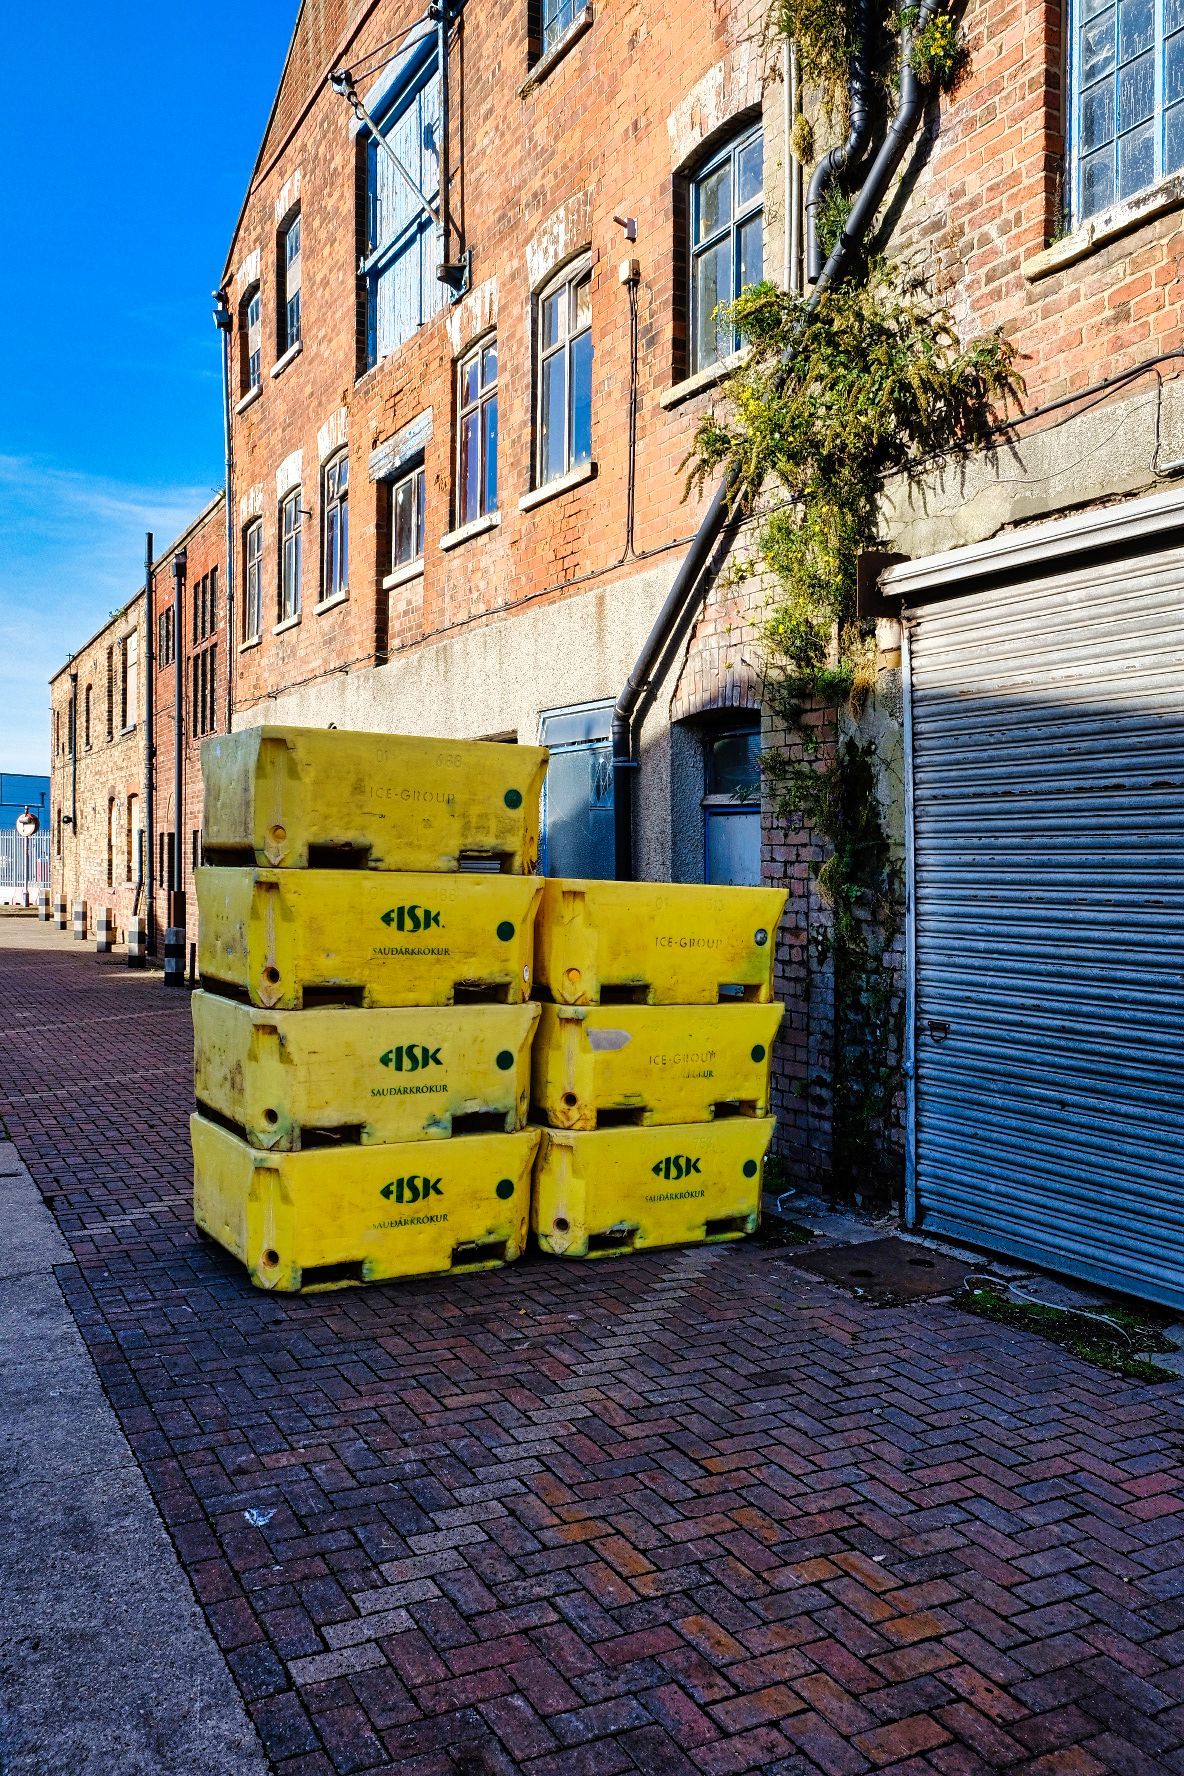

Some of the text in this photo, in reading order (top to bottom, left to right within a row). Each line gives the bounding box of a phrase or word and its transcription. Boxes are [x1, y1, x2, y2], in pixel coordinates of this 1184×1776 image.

[370, 786, 456, 804] ICE-GROUP
[380, 905, 441, 933] FISK
[655, 936, 723, 949] ICE-GROUP
[379, 1044, 444, 1072] FISK
[370, 1083, 449, 1097] SAUÐÁRKRÓKUR
[651, 1154, 702, 1180] FISK
[379, 1175, 445, 1203] FISK
